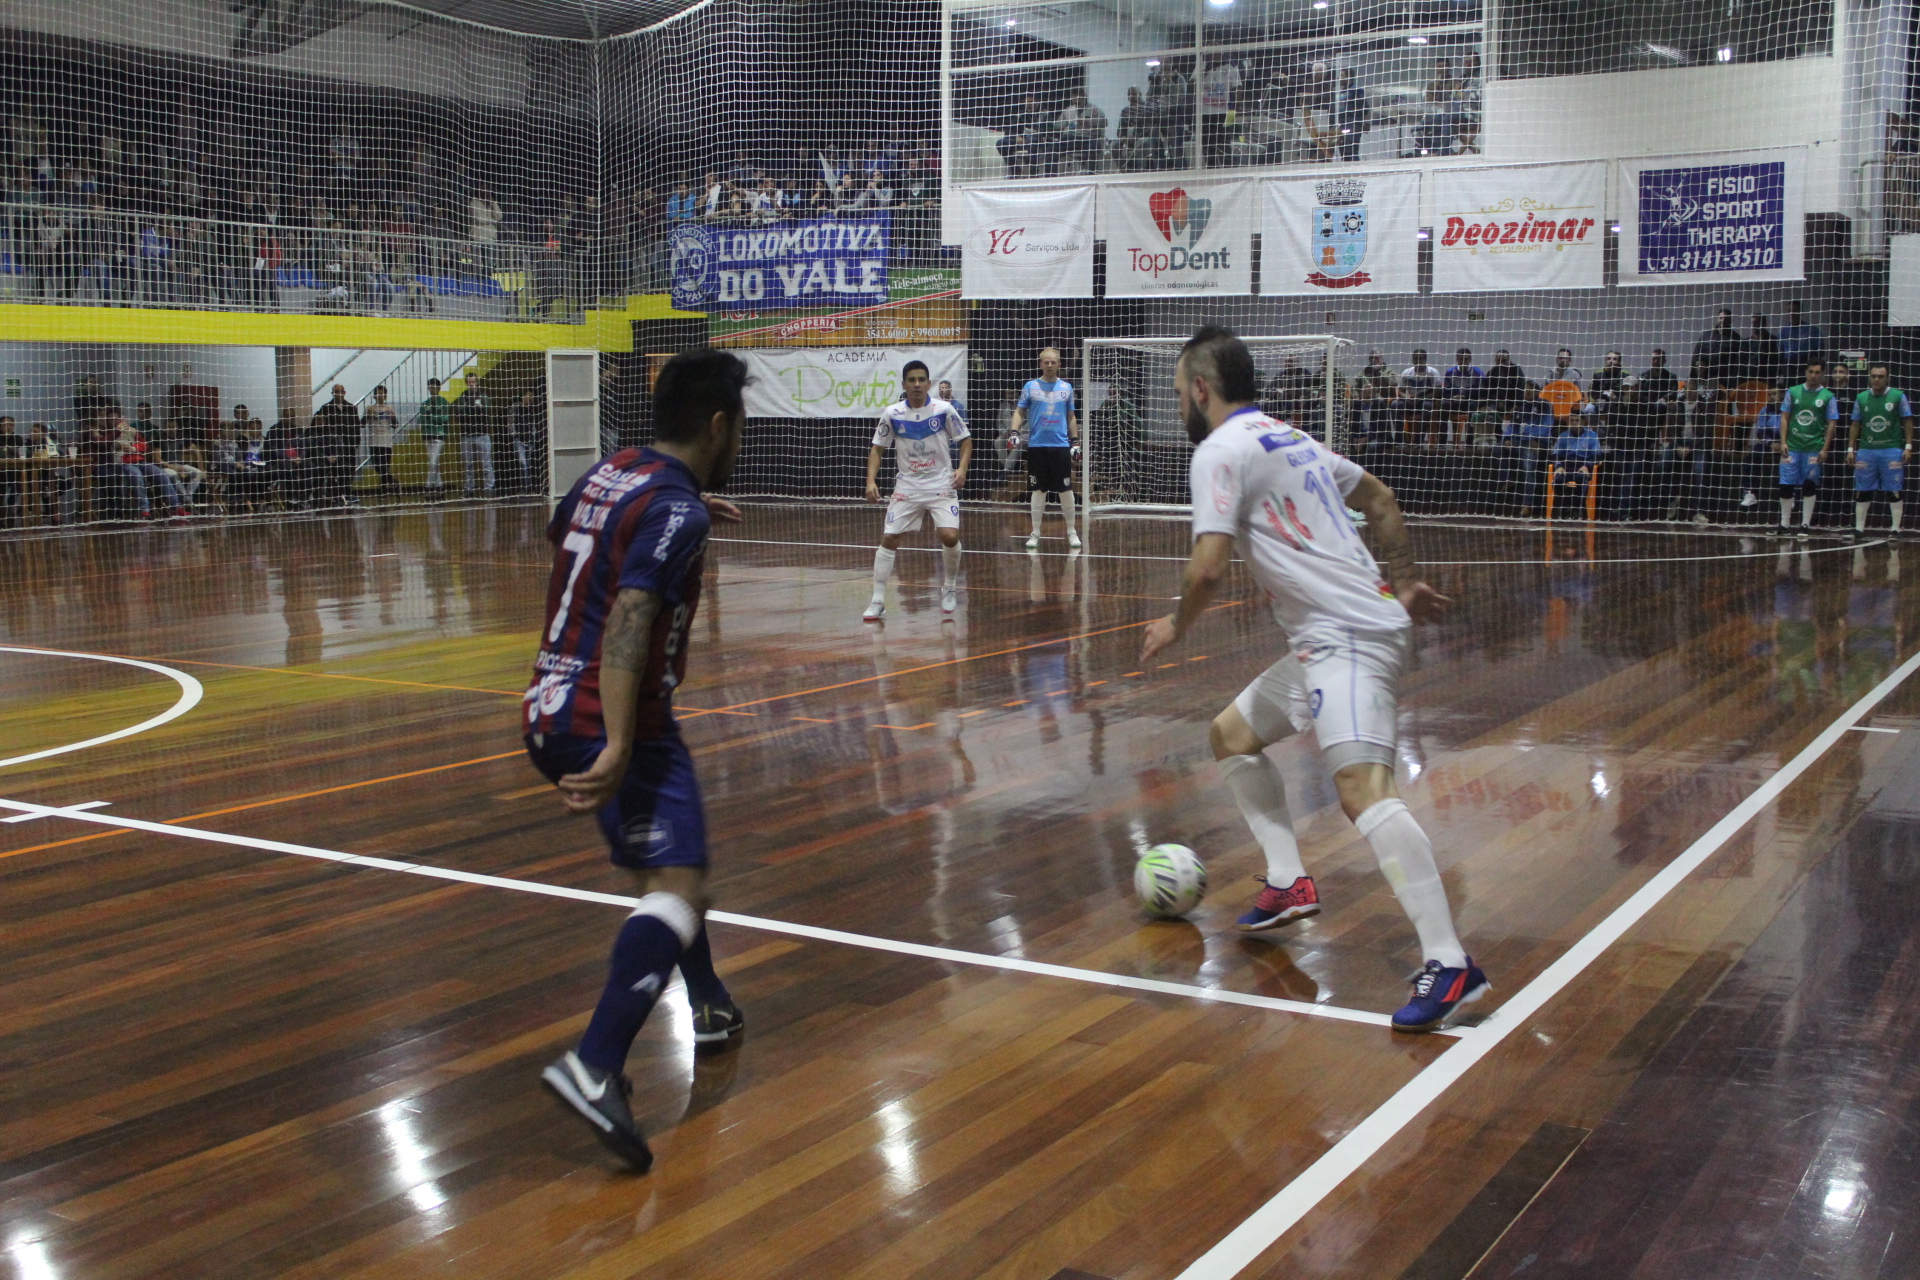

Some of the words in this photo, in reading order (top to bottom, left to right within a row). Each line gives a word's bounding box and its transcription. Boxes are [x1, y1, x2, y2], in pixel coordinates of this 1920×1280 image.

[1707, 175, 1755, 196] FISIO
[1702, 200, 1765, 220] SPORT
[1441, 212, 1595, 246] Deozimar
[1687, 224, 1774, 246] THERAPY
[718, 222, 885, 262] LOKOMOTIVA
[987, 227, 1025, 255] YC
[1026, 243, 1059, 253] Serviços
[1062, 243, 1080, 252] Ltda
[1489, 245, 1543, 254] RESTAURANTE
[1127, 246, 1231, 278] TopDent
[1660, 256, 1675, 270] 51
[1680, 247, 1775, 270] 3141-3510
[718, 270, 764, 301] DO
[775, 260, 884, 297] VALE
[892, 272, 943, 291] Tele-almoço
[781, 318, 836, 336] CHOPPERIA
[827, 351, 888, 363] ACADEMIA
[549, 530, 595, 643] 7
